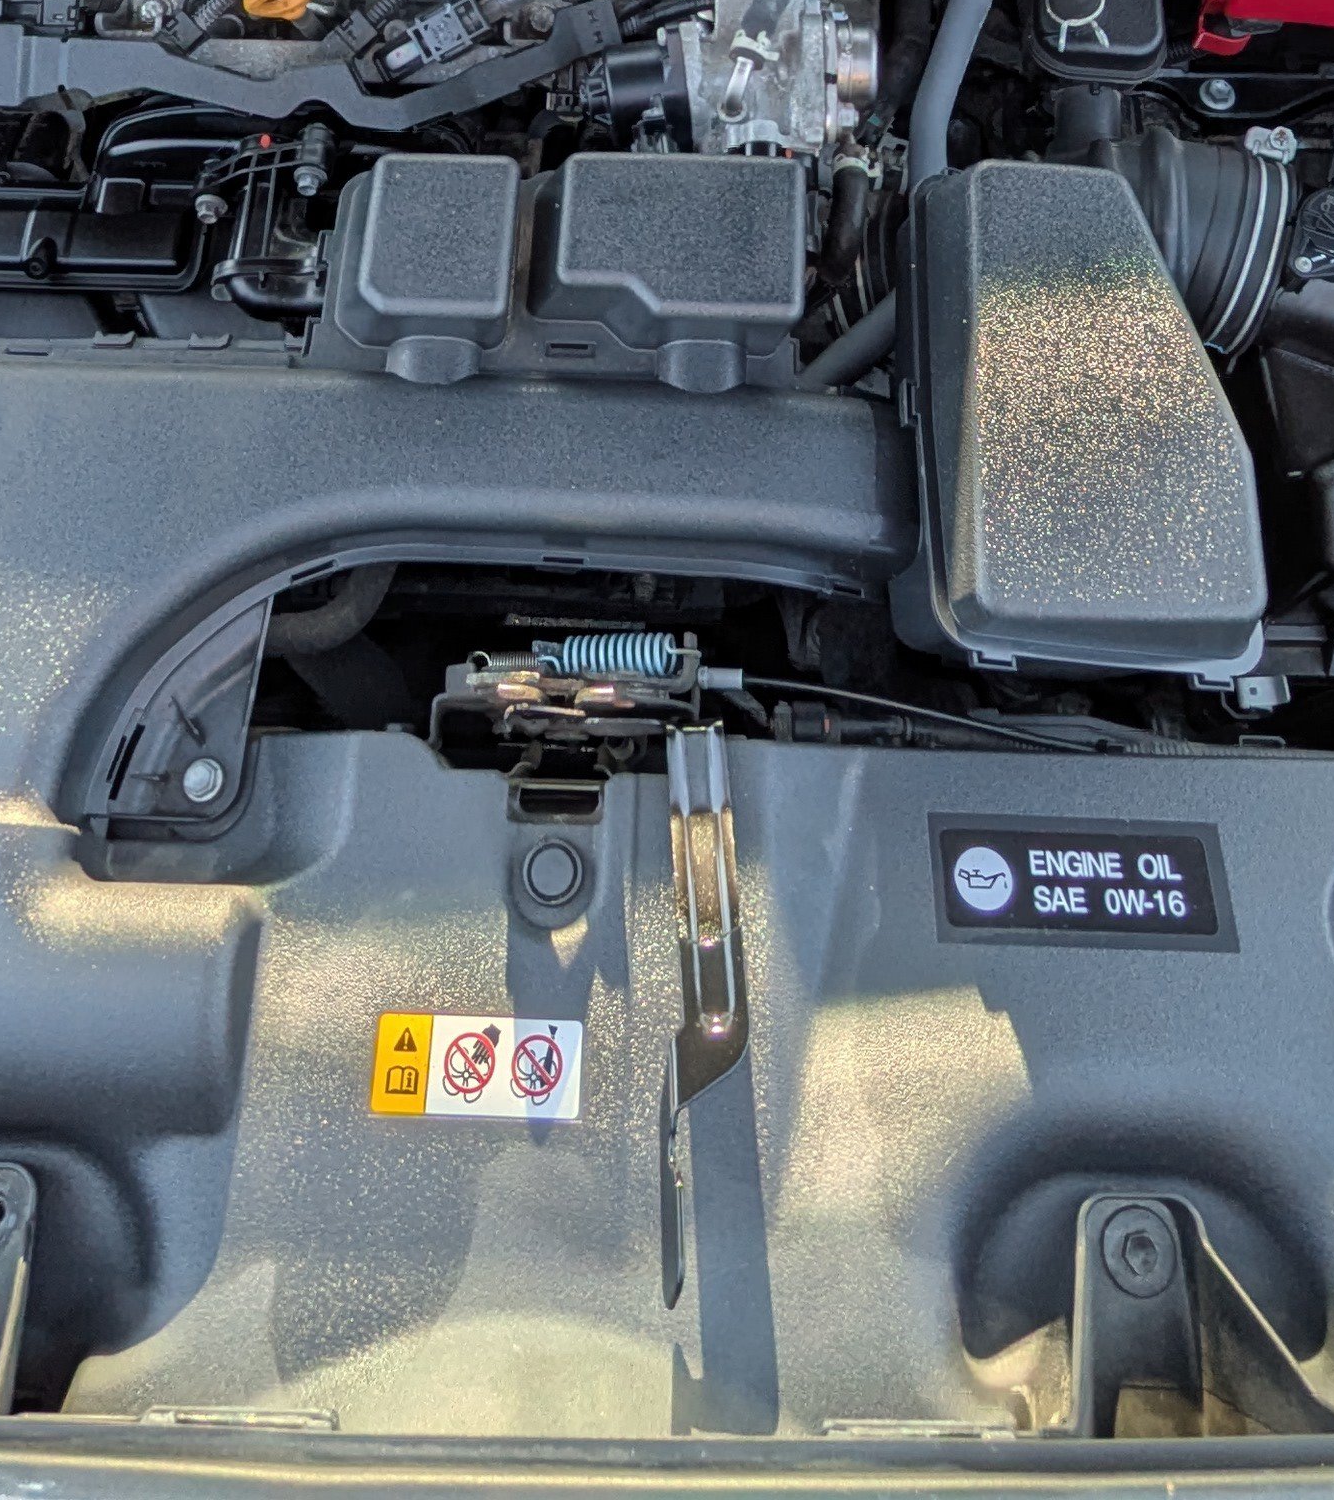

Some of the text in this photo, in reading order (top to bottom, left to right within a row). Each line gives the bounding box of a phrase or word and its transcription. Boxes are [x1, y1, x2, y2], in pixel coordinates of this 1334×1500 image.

[1029, 850, 1183, 881] ENGINE OIL
[1033, 885, 1186, 918] SAE 0W-16
